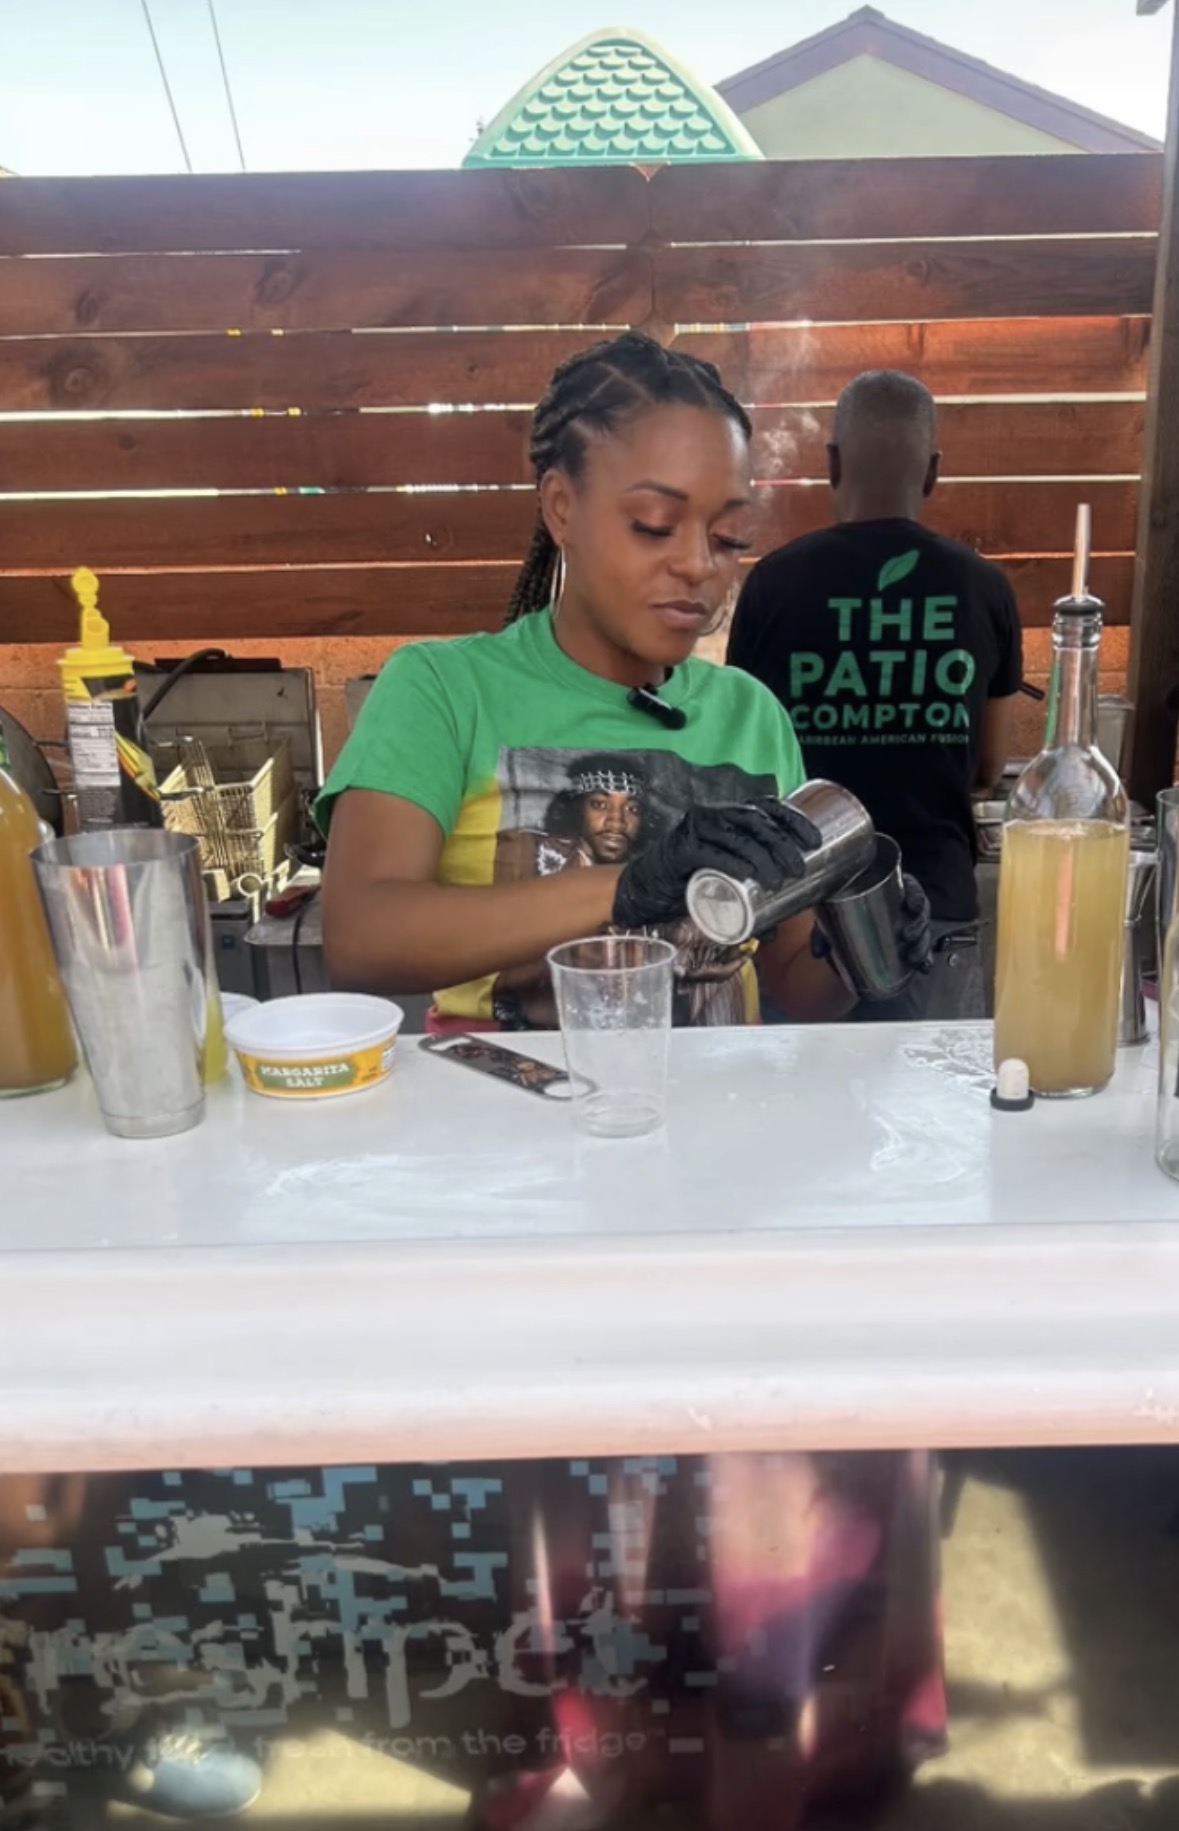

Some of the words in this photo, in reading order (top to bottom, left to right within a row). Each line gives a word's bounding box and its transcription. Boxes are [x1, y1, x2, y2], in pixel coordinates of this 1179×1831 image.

[828, 596, 957, 641] THE
[790, 649, 976, 697] PATIO
[860, 733, 926, 745] AMERICAN
[261, 1062, 349, 1077] MARGARITA
[286, 1076, 324, 1088] SALT
[362, 1730, 452, 1757] from
[461, 1728, 528, 1755] the
